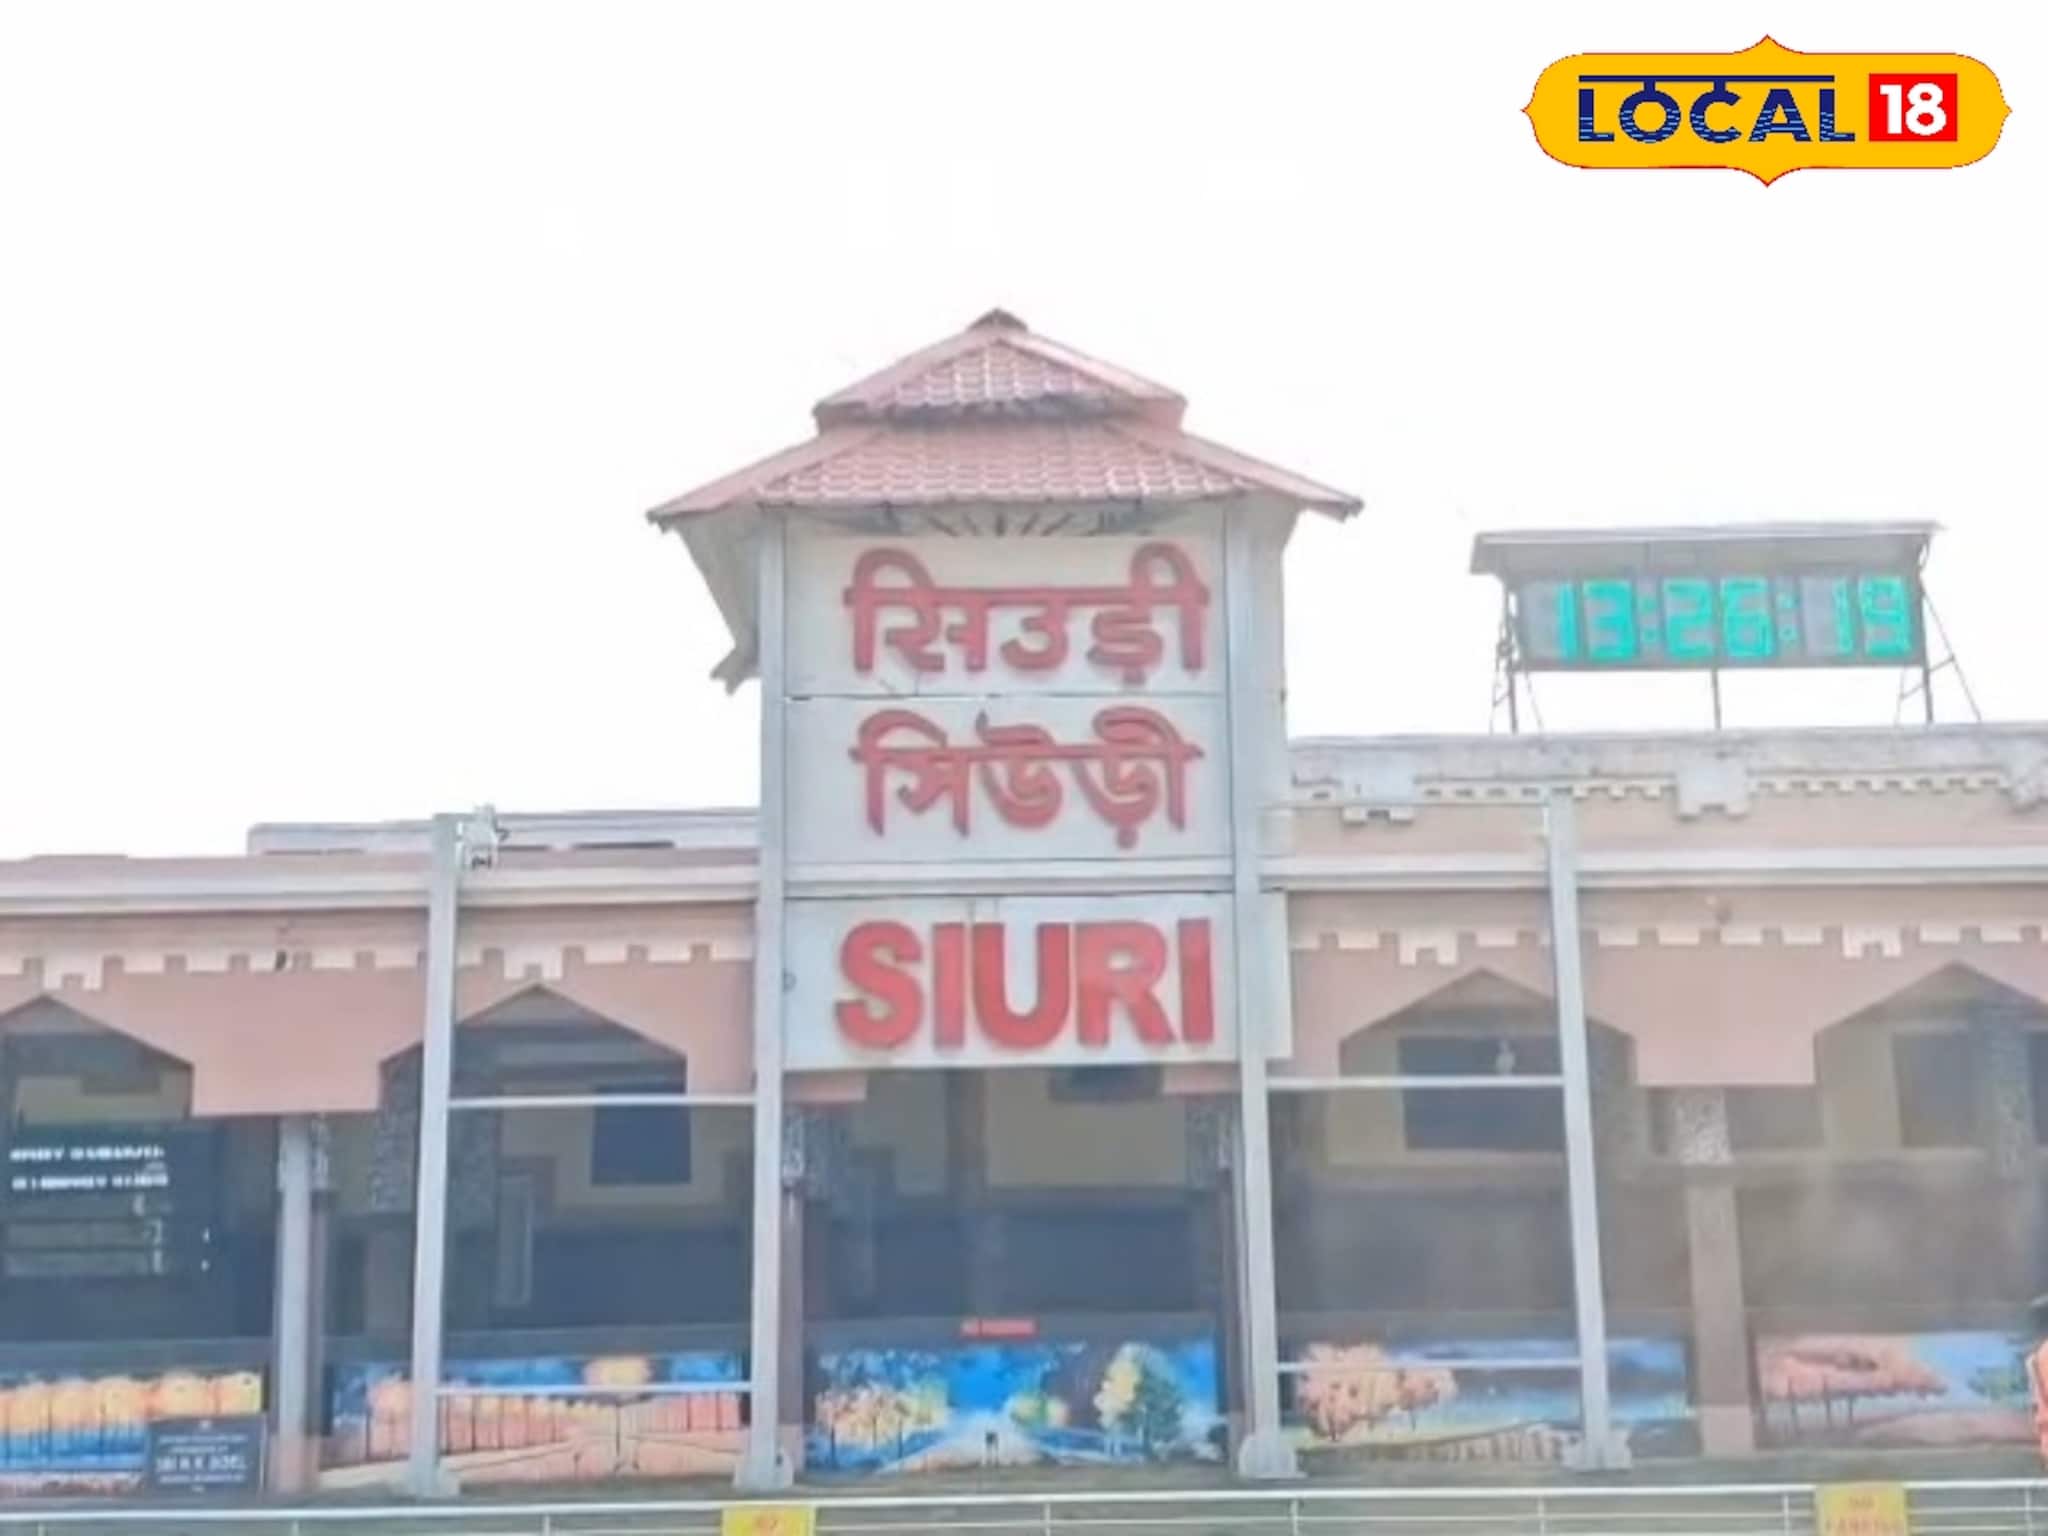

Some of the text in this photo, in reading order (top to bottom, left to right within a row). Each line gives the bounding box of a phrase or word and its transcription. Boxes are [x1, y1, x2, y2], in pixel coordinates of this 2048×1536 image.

[843, 542, 1210, 685] सिउड़ी
[1557, 577, 1912, 661] 13:26:19
[836, 918, 1214, 1050] SIURI
